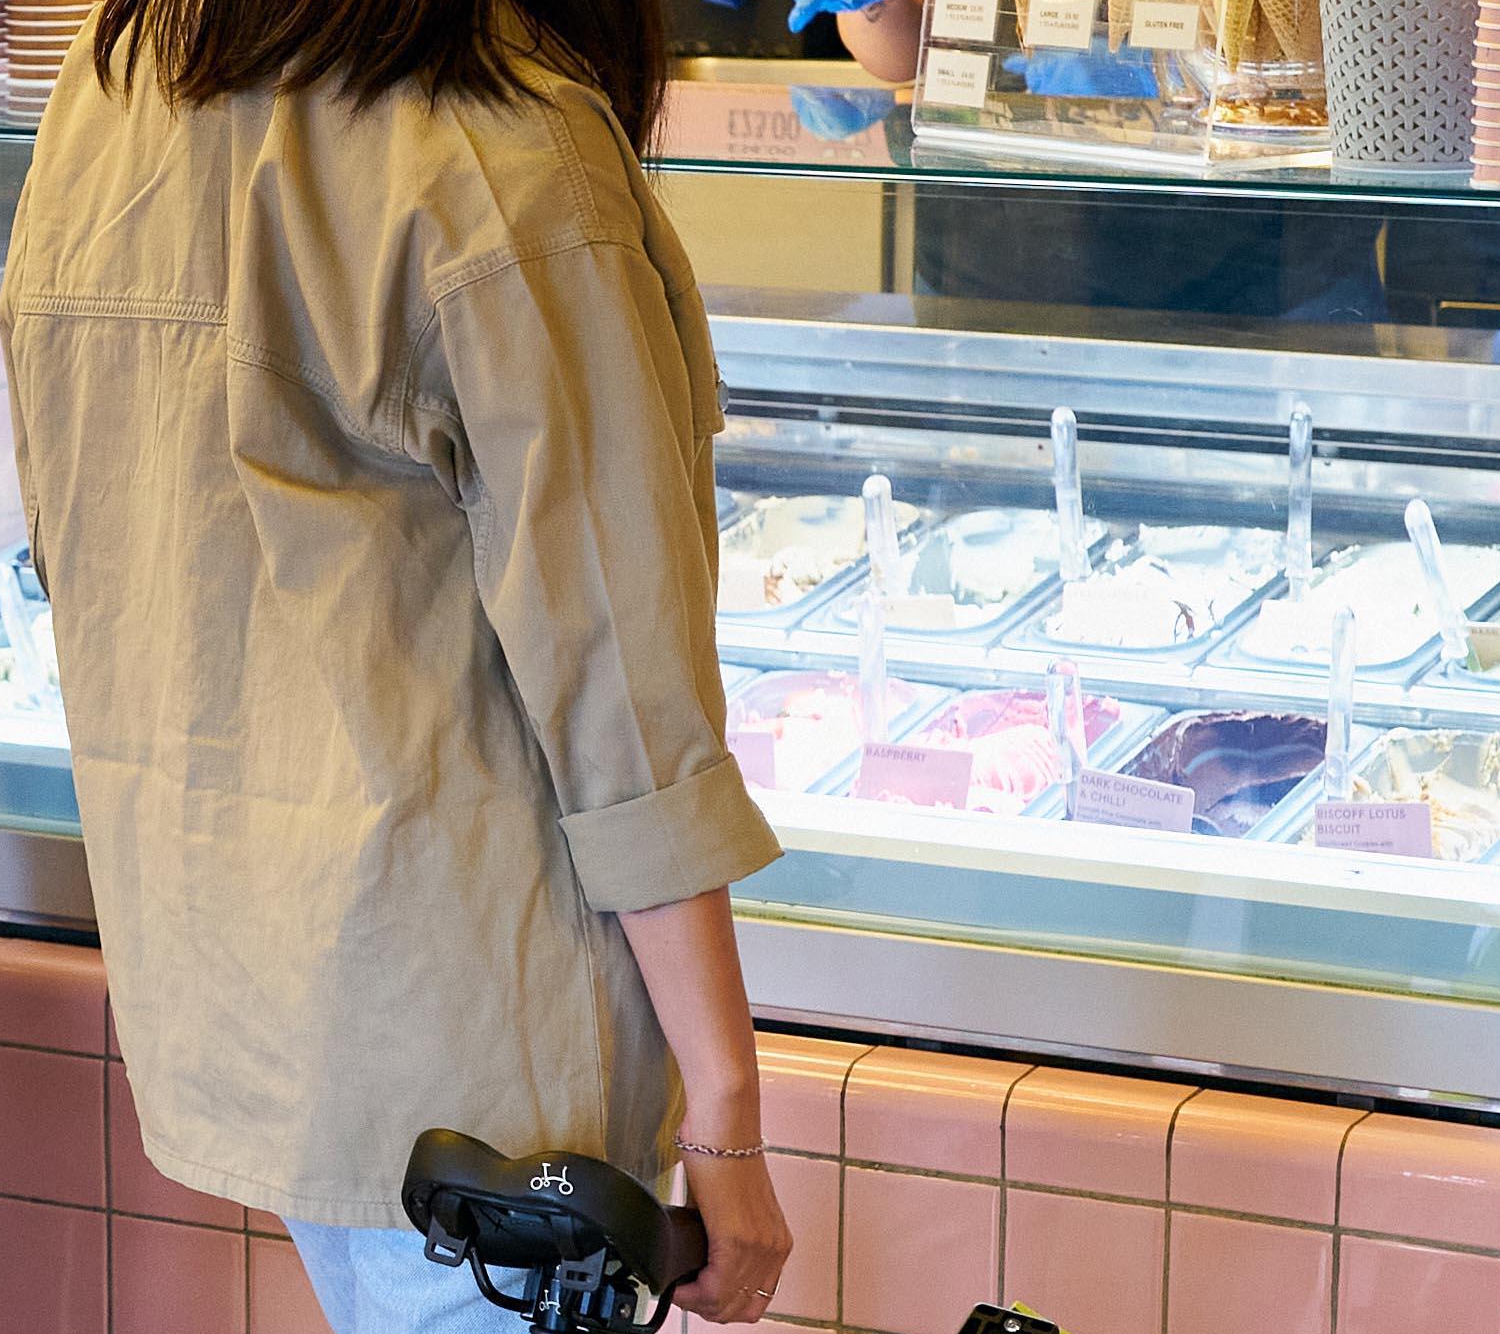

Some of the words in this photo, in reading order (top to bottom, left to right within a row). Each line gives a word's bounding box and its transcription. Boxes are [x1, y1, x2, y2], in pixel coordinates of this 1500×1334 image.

[1144, 20, 1168, 30] GLUTEN
[1168, 21, 1185, 31] FREE
[865, 746, 927, 764] RASPBERRY
[1081, 774, 1111, 787] DARK
[1113, 781, 1185, 805] CHOCOLATE
[1090, 791, 1126, 807] CHILLI
[1317, 808, 1363, 820] BISCOFF
[1369, 809, 1407, 820] LOTUS
[1317, 823, 1361, 835] BISCUIT
